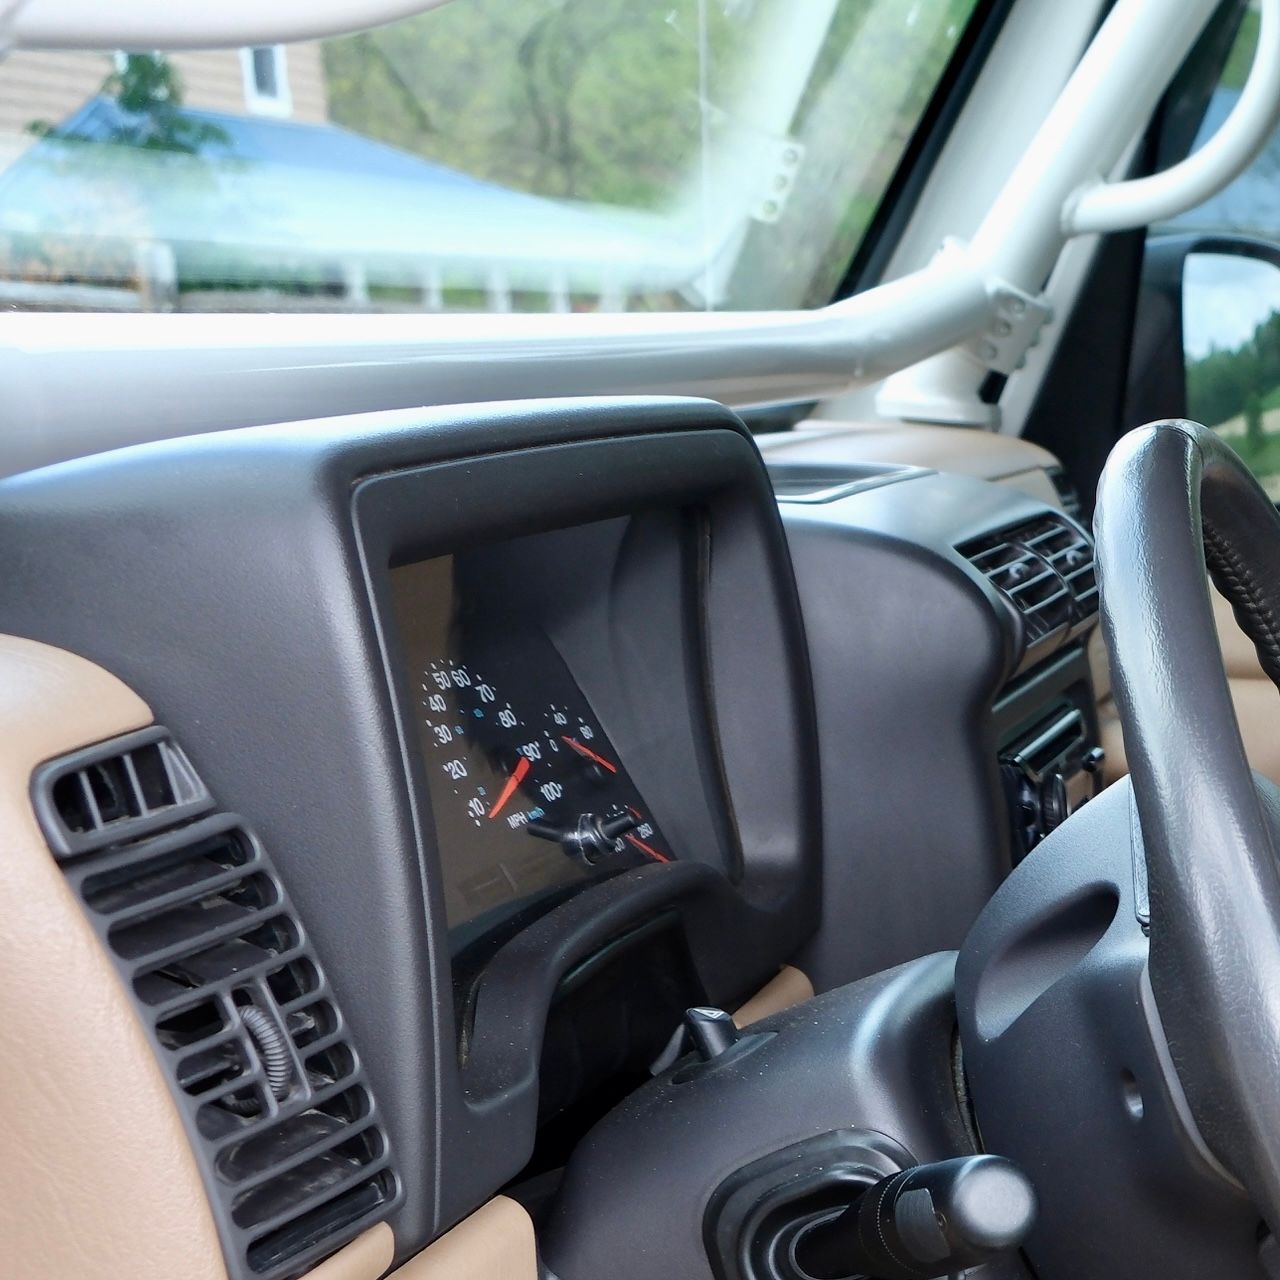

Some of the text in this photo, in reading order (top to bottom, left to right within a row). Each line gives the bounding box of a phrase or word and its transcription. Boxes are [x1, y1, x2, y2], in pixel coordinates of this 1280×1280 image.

[432, 670, 451, 690] 50
[451, 669, 471, 688] 60
[428, 694, 447, 712] 40
[475, 684, 496, 703] 70
[498, 709, 518, 728] 80
[554, 712, 567, 726] 40
[434, 724, 453, 744] 30
[522, 742, 541, 762] 90
[549, 739, 559, 752] 0
[447, 759, 468, 780] 20
[540, 781, 562, 802] 100
[468, 797, 485, 817] 10
[507, 812, 528, 829] MPH
